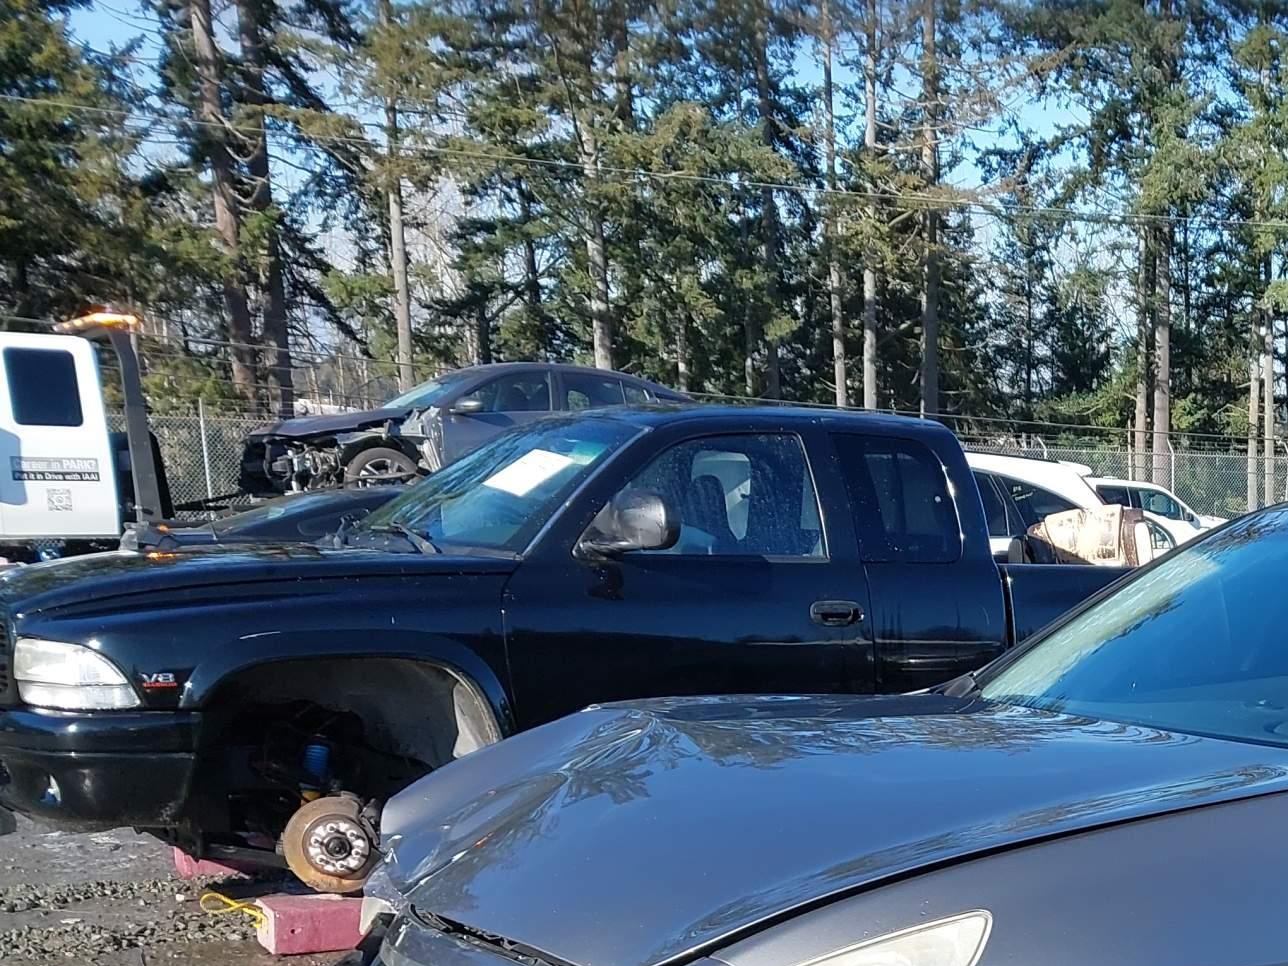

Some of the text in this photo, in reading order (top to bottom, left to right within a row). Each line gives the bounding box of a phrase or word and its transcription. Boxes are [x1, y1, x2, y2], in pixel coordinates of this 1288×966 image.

[62, 459, 96, 470] PARK?
[44, 472, 64, 480] Drive
[65, 472, 81, 480] with
